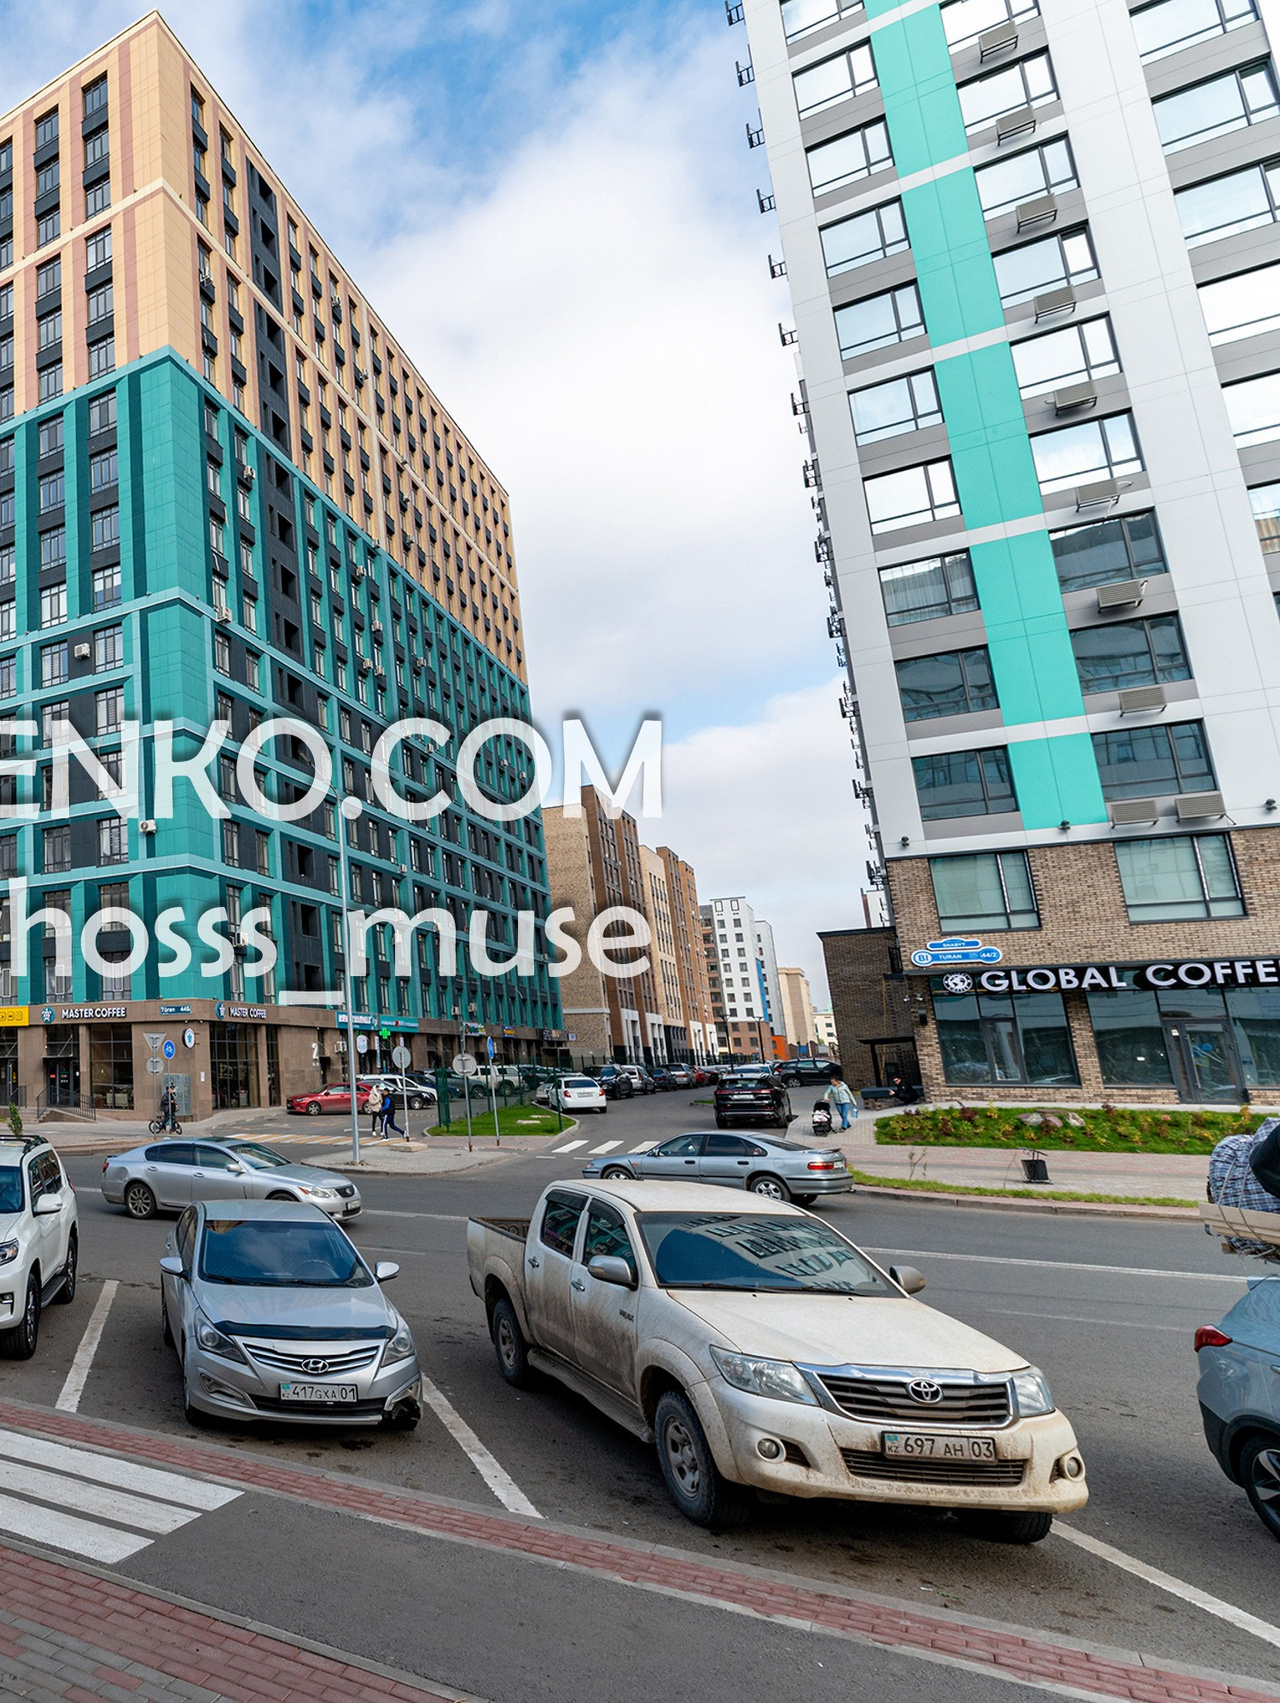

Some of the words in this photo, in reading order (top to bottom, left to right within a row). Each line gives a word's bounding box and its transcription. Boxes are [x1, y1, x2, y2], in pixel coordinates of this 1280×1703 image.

[980, 966, 1127, 992] GLOBAL
[1145, 959, 1280, 987] COFFE
[61, 1007, 95, 1019] MASTER
[95, 1006, 127, 1018] COFFEE
[229, 1006, 249, 1018] MASTER
[249, 1008, 267, 1019] COFFEE
[312, 1043, 319, 1059] 2
[340, 1387, 356, 1401] 01
[887, 1444, 900, 1454] KZ
[904, 1437, 935, 1455] 697
[943, 1443, 964, 1457] AH
[971, 1440, 993, 1458] 03
